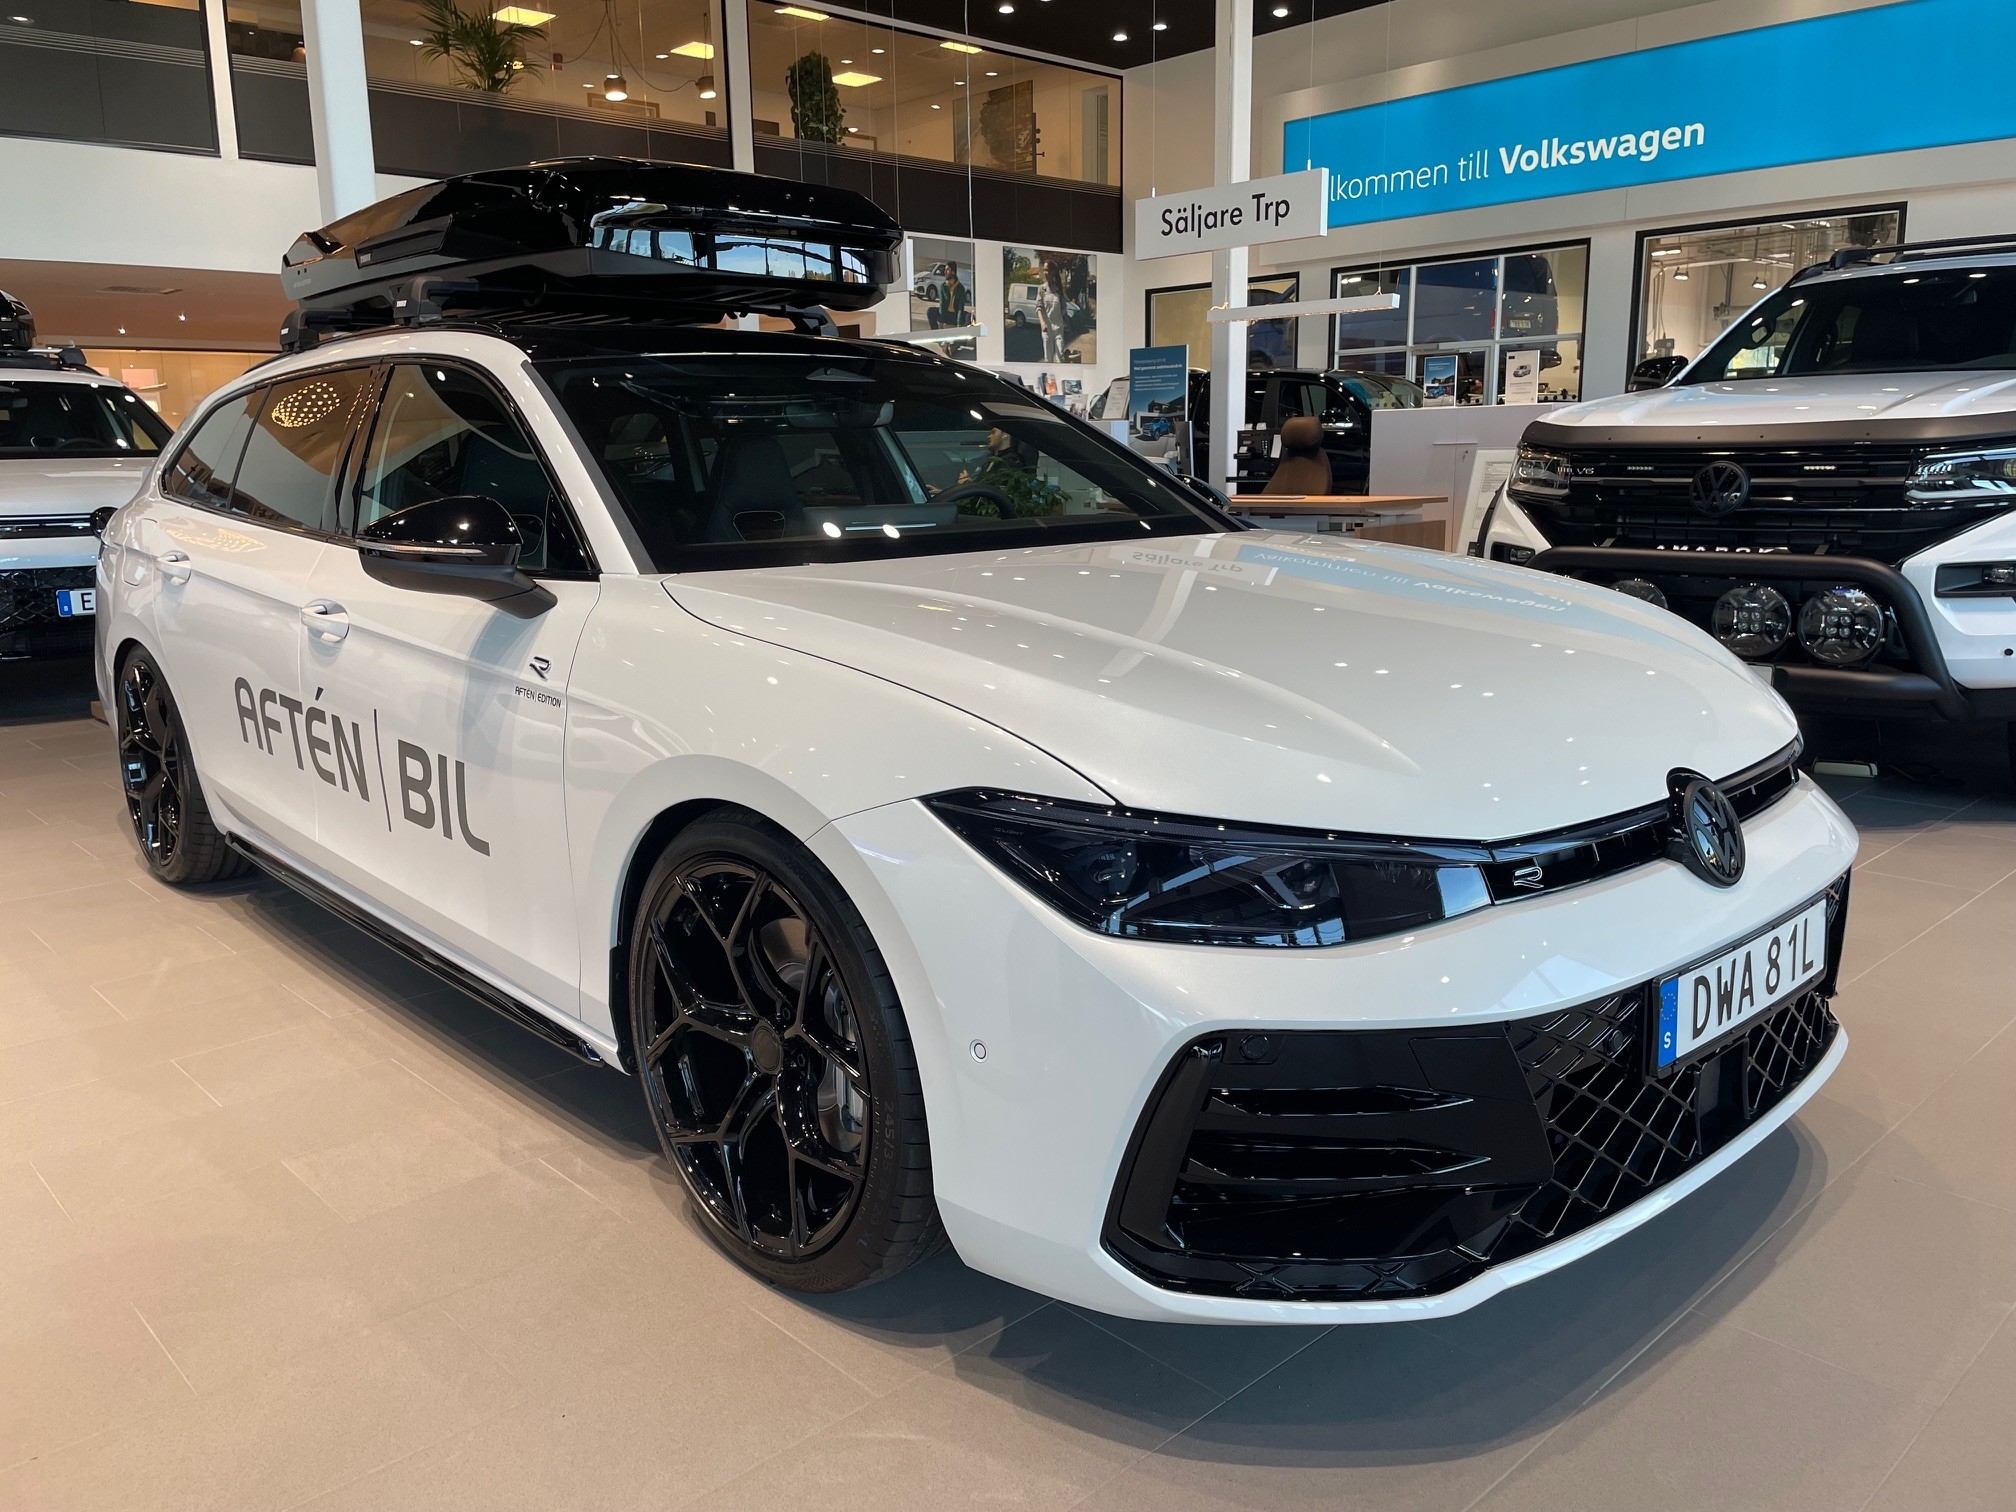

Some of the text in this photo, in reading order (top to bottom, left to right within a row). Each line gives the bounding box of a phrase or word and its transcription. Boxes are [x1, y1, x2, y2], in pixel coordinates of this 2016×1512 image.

[1329, 122, 1705, 202] lkommen till Volkswagen
[1160, 193, 1291, 238] Säljare Trp
[537, 692, 562, 708] EDITION
[233, 676, 491, 857] AFTÉN BIL
[1692, 917, 1814, 1041] DWA 81L
[1663, 1031, 1671, 1049] S
